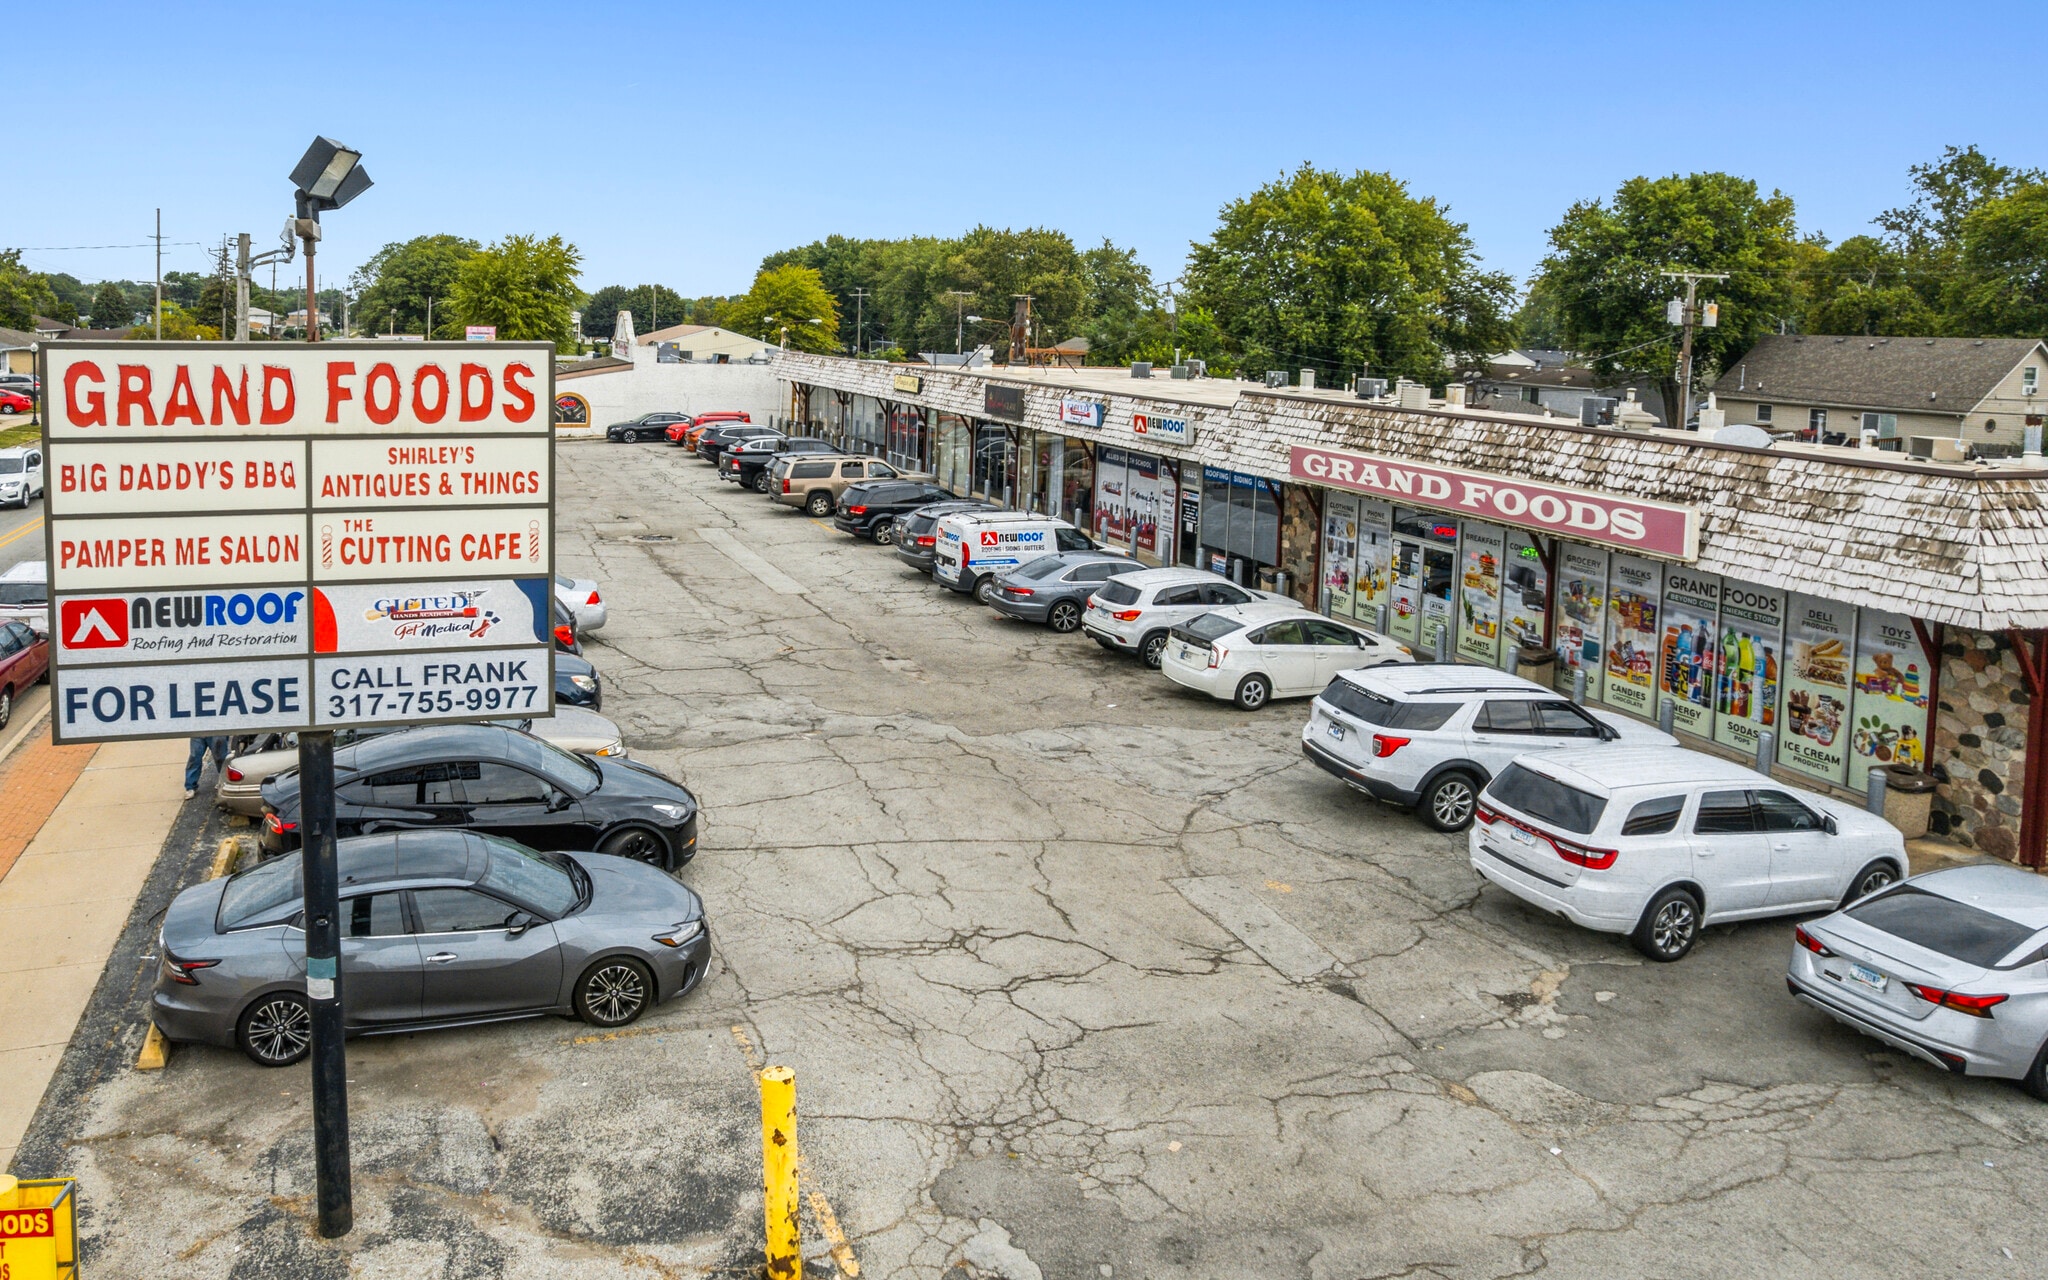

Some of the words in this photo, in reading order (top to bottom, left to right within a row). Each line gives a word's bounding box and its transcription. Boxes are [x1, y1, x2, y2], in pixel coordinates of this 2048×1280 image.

[64, 360, 296, 428] GRAND
[325, 360, 536, 425] FOODS
[388, 446, 475, 465] SHIRLEY'S
[1105, 452, 1119, 461] ALLIED
[1135, 458, 1152, 468] SCHOOL
[61, 462, 107, 492] BIG
[119, 461, 234, 491] DADDY'S
[245, 461, 296, 490] BBQ
[1205, 469, 1229, 481] ROOFING
[1233, 474, 1253, 486] SIDING
[321, 473, 430, 498] ANTIQUES
[438, 472, 453, 496] &
[461, 471, 539, 495] THINGS
[1303, 453, 1452, 500] GRAND
[1460, 480, 1646, 540] FOODS
[1329, 501, 1354, 513] CLOTHING
[1366, 509, 1385, 519] PHONE
[343, 519, 373, 532] THE
[1433, 525, 1457, 537] OPEN
[1465, 533, 1502, 547] BREAKFAST
[60, 538, 166, 569] PAMPER
[175, 537, 210, 566] ME
[220, 534, 299, 565] SALON
[340, 534, 451, 565] CUTTING
[460, 532, 522, 561] CAFE
[1566, 554, 1602, 569] GROCERY
[1570, 565, 1596, 576] PRODUCTS
[1619, 566, 1652, 580] SNACKS
[1626, 579, 1643, 587] CHIPS
[1669, 575, 1718, 598] GRAND
[1723, 587, 1777, 612] FOODS
[373, 595, 469, 614] GIFTED
[1391, 600, 1417, 614] LOTTERY
[1431, 601, 1444, 610] ATM
[1670, 593, 1697, 606] BEYOND
[1754, 613, 1777, 625] STORE
[419, 611, 454, 619] ACADEMY
[1808, 609, 1833, 622] DELI
[394, 621, 424, 640] Get
[421, 619, 475, 637] Medical
[1394, 625, 1411, 635] LOTTERY
[1801, 619, 1839, 634] PRODUCTS
[1881, 625, 1912, 640] TOYS
[133, 635, 184, 653] Roofing
[187, 634, 215, 649] And
[218, 631, 297, 647] Restoration
[1465, 636, 1490, 650] PLANTS
[1884, 639, 1907, 650] GIFTS
[1477, 649, 1495, 660] SUPPLIES
[331, 666, 412, 690] CALL
[423, 660, 528, 686] FRANK
[1610, 683, 1646, 701] CANDIES
[66, 685, 156, 724] FOR
[169, 677, 299, 718] LEASE
[329, 685, 538, 718] 317-755-9977
[1612, 694, 1643, 709] CHOCOLATE
[1673, 701, 1702, 719] NERGY
[1727, 721, 1759, 738] SODAS
[1734, 735, 1751, 745] POPS
[1784, 740, 1800, 753] ICE
[1803, 747, 1840, 766] CREAM
[1793, 755, 1830, 772] PRODUCTS
[0, 1213, 49, 1235] ODS
